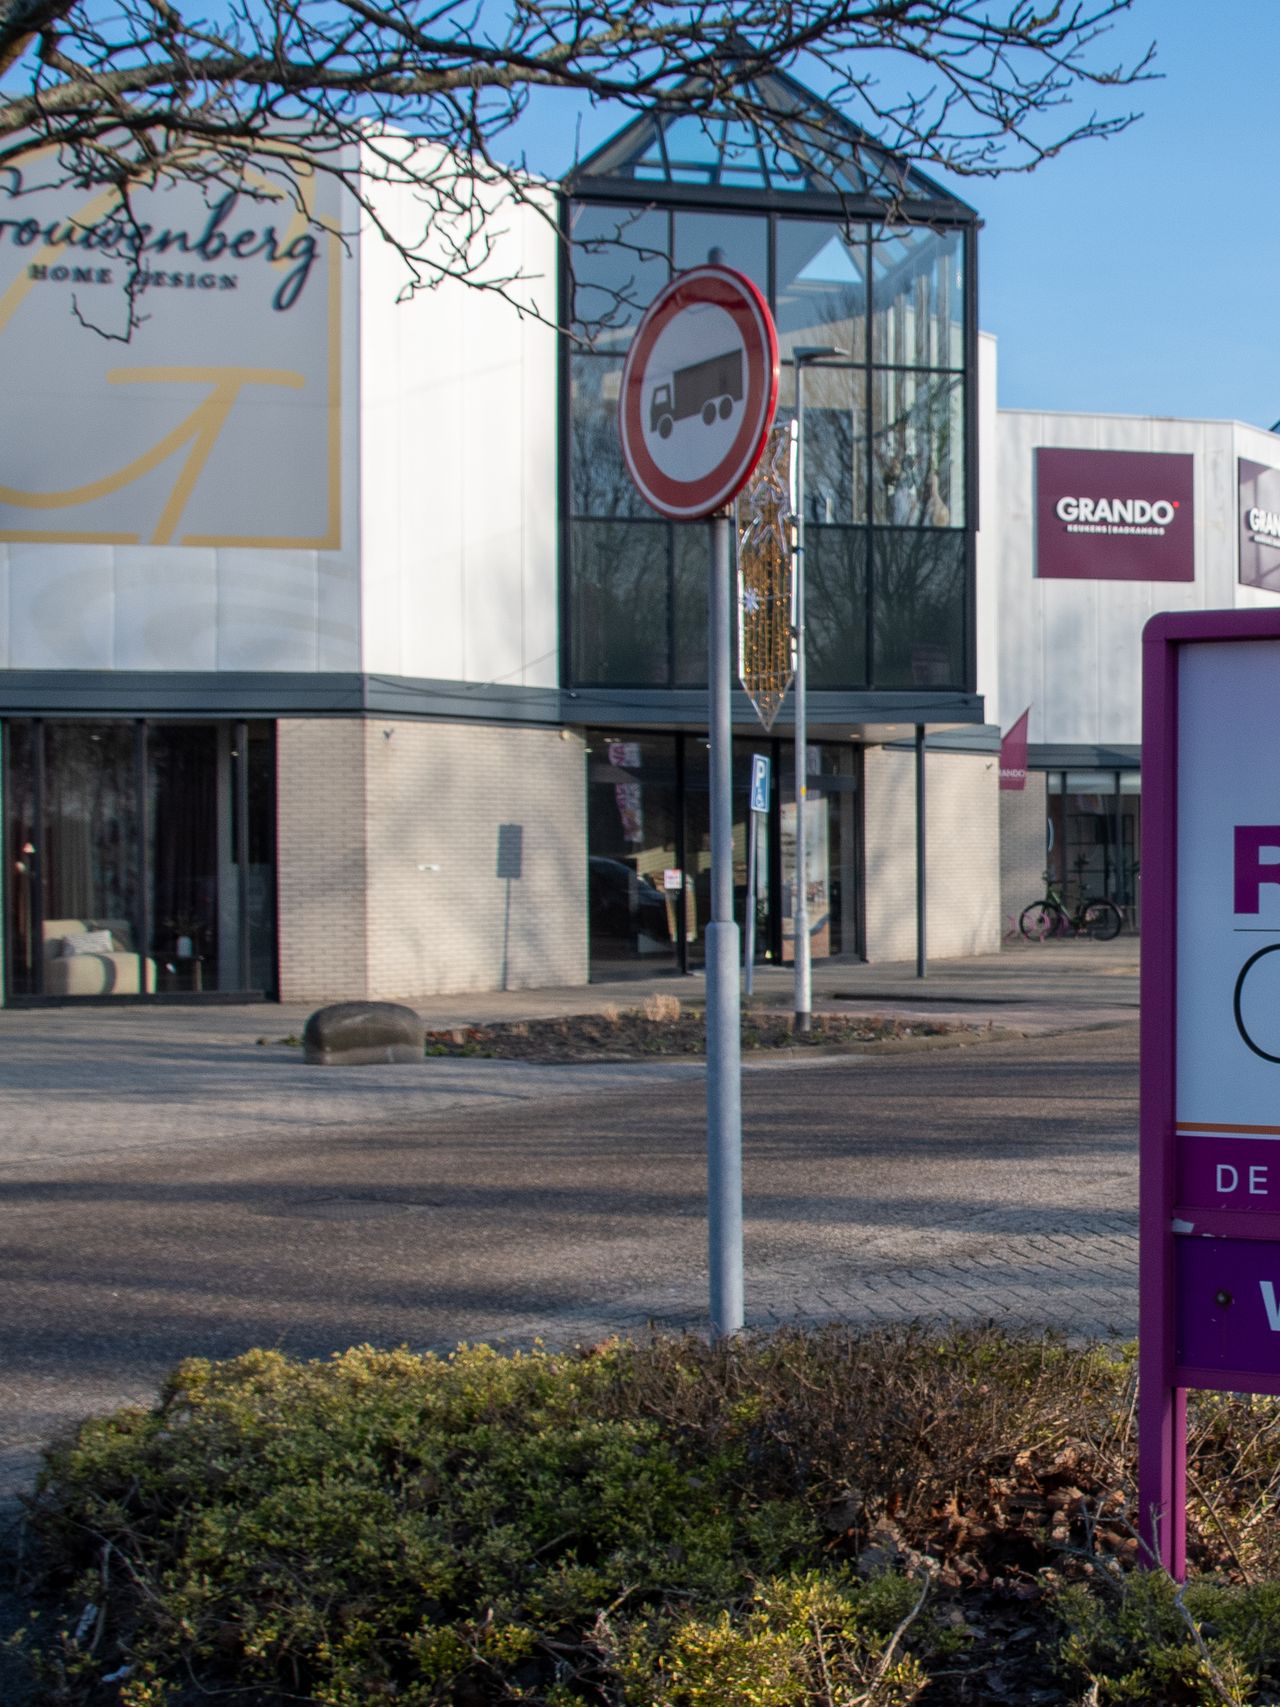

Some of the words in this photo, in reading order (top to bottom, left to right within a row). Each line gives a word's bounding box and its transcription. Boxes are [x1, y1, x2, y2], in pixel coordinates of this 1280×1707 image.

[28, 264, 112, 284] HOME
[134, 268, 239, 289] DESIGN
[1056, 496, 1175, 525] GRANDO
[1215, 1163, 1271, 1196] DE
